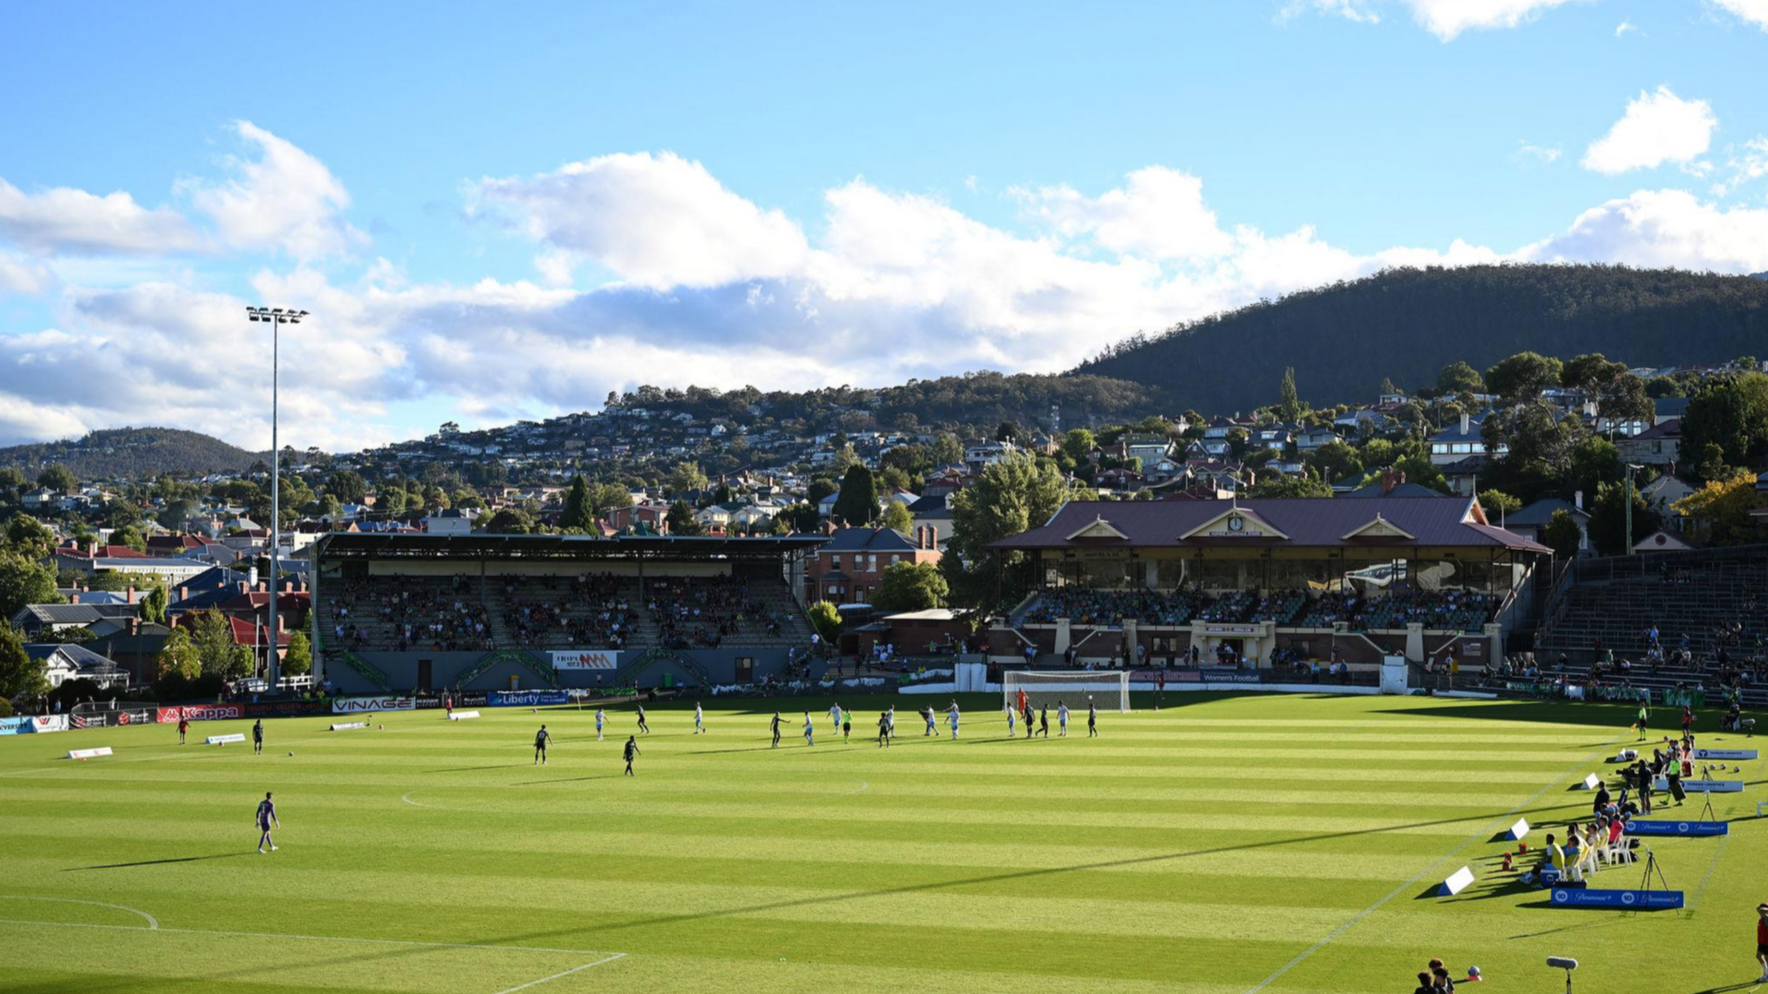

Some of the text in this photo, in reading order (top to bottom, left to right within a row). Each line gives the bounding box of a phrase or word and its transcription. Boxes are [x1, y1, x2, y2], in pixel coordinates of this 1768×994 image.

[503, 694, 539, 705] Liberty
[182, 706, 239, 720] Kappa
[1574, 892, 1612, 901] Paramount+
